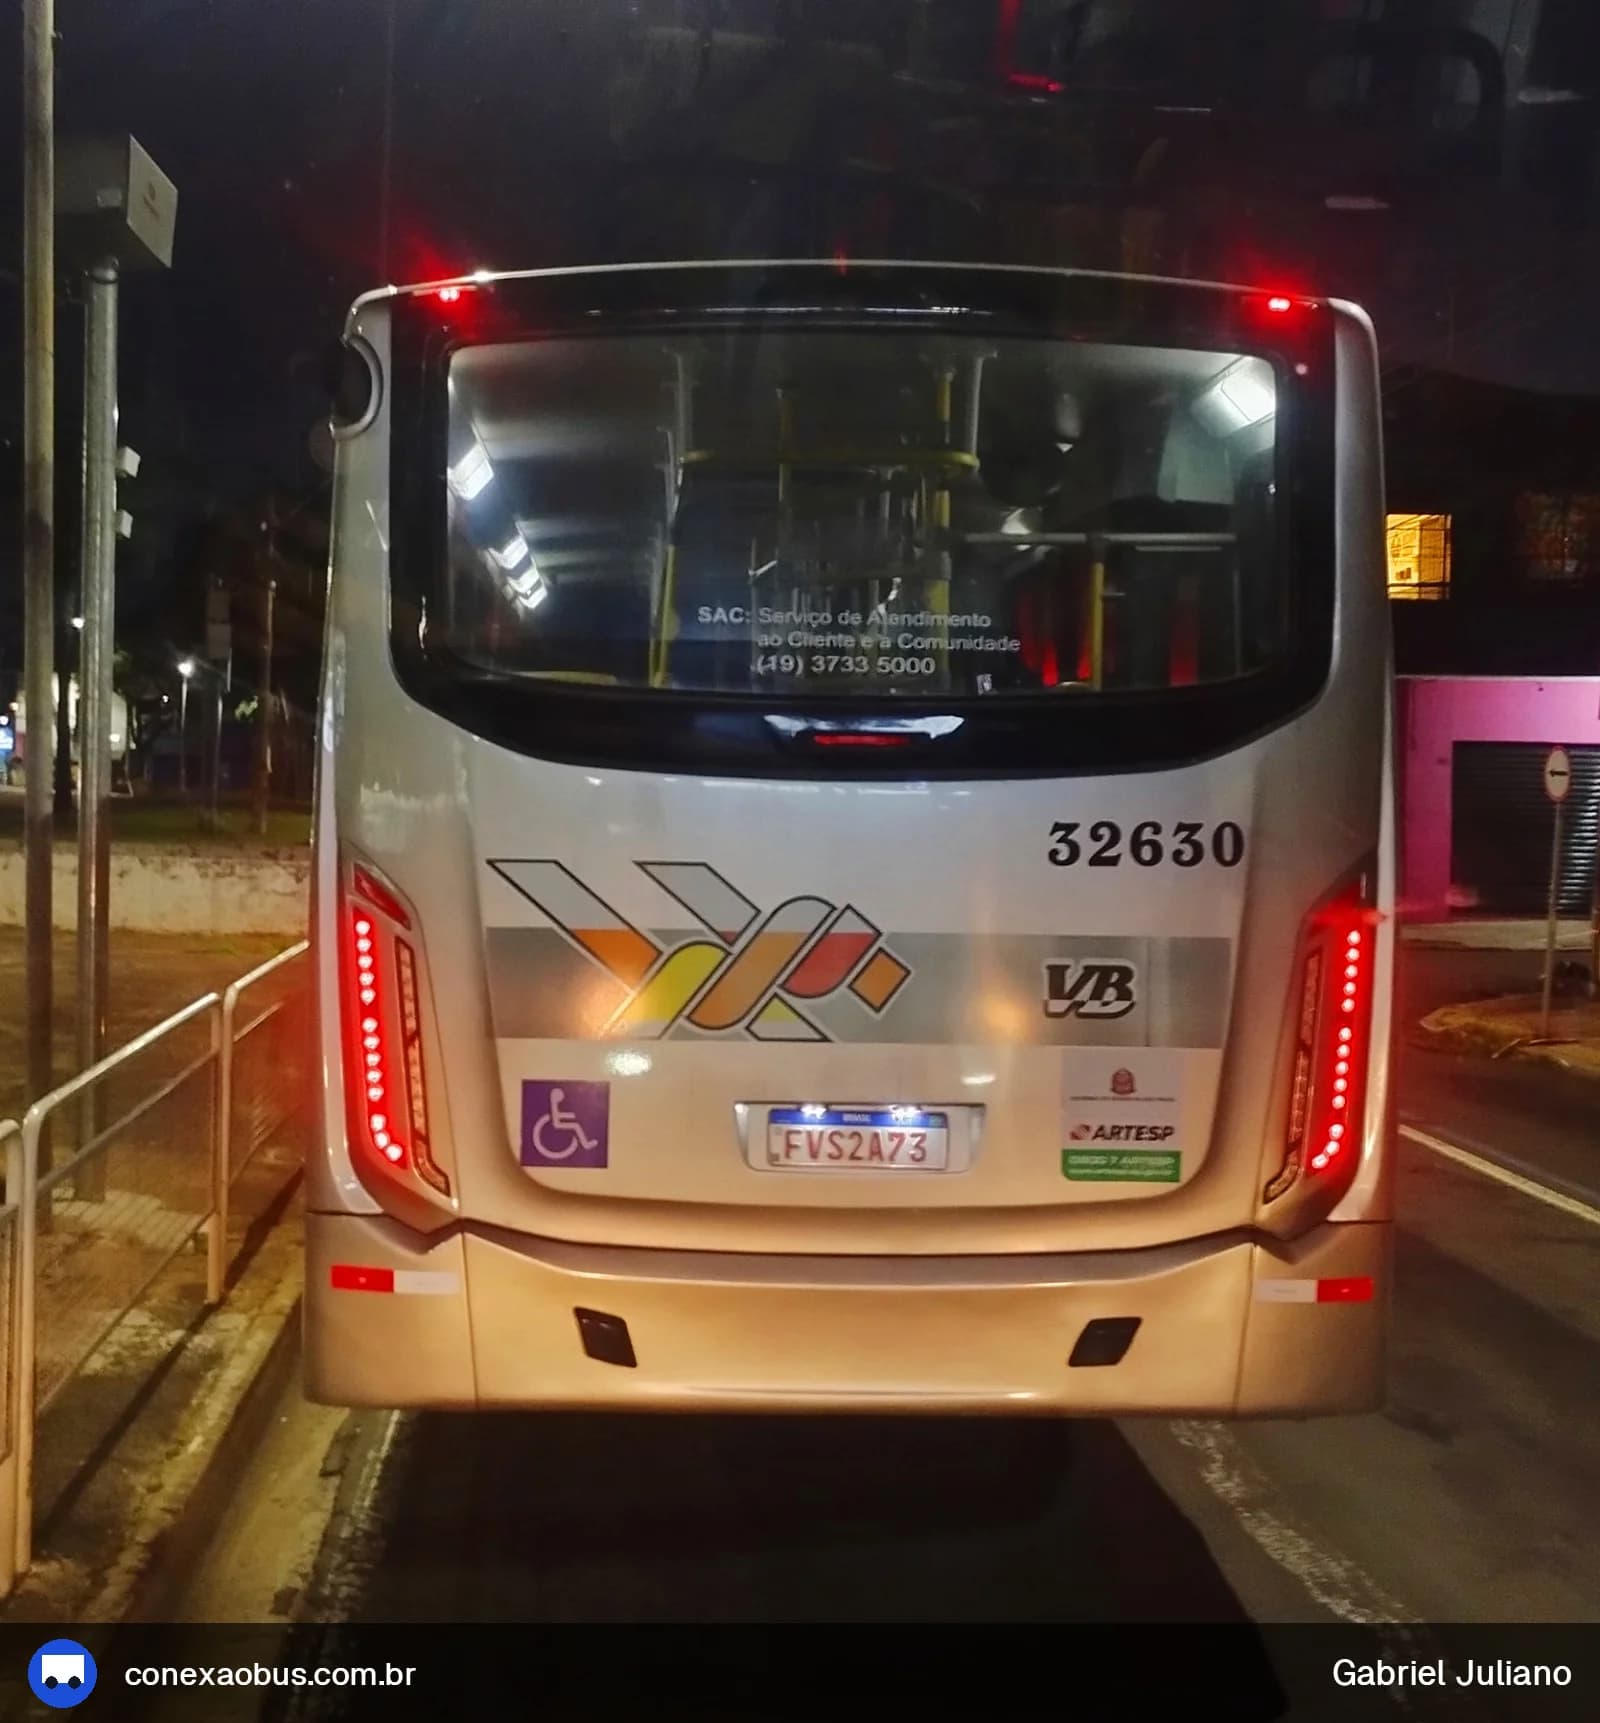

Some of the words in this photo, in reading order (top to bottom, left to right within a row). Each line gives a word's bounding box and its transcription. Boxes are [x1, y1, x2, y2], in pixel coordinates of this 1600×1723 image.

[697, 606, 751, 624] SAC:
[757, 607, 833, 628] Serviço
[837, 609, 862, 625] de
[757, 633, 782, 648] ao
[787, 631, 856, 648] Cliente
[861, 636, 873, 648] e
[897, 633, 1021, 651] Comunidade
[757, 655, 804, 675] (19)
[811, 656, 869, 673] 3733
[876, 657, 936, 674] 5000
[1048, 821, 1245, 867] 32630
[1044, 963, 1136, 1019] VB
[1091, 1124, 1176, 1142] ARTESP
[784, 1130, 927, 1162] FVS2A73
